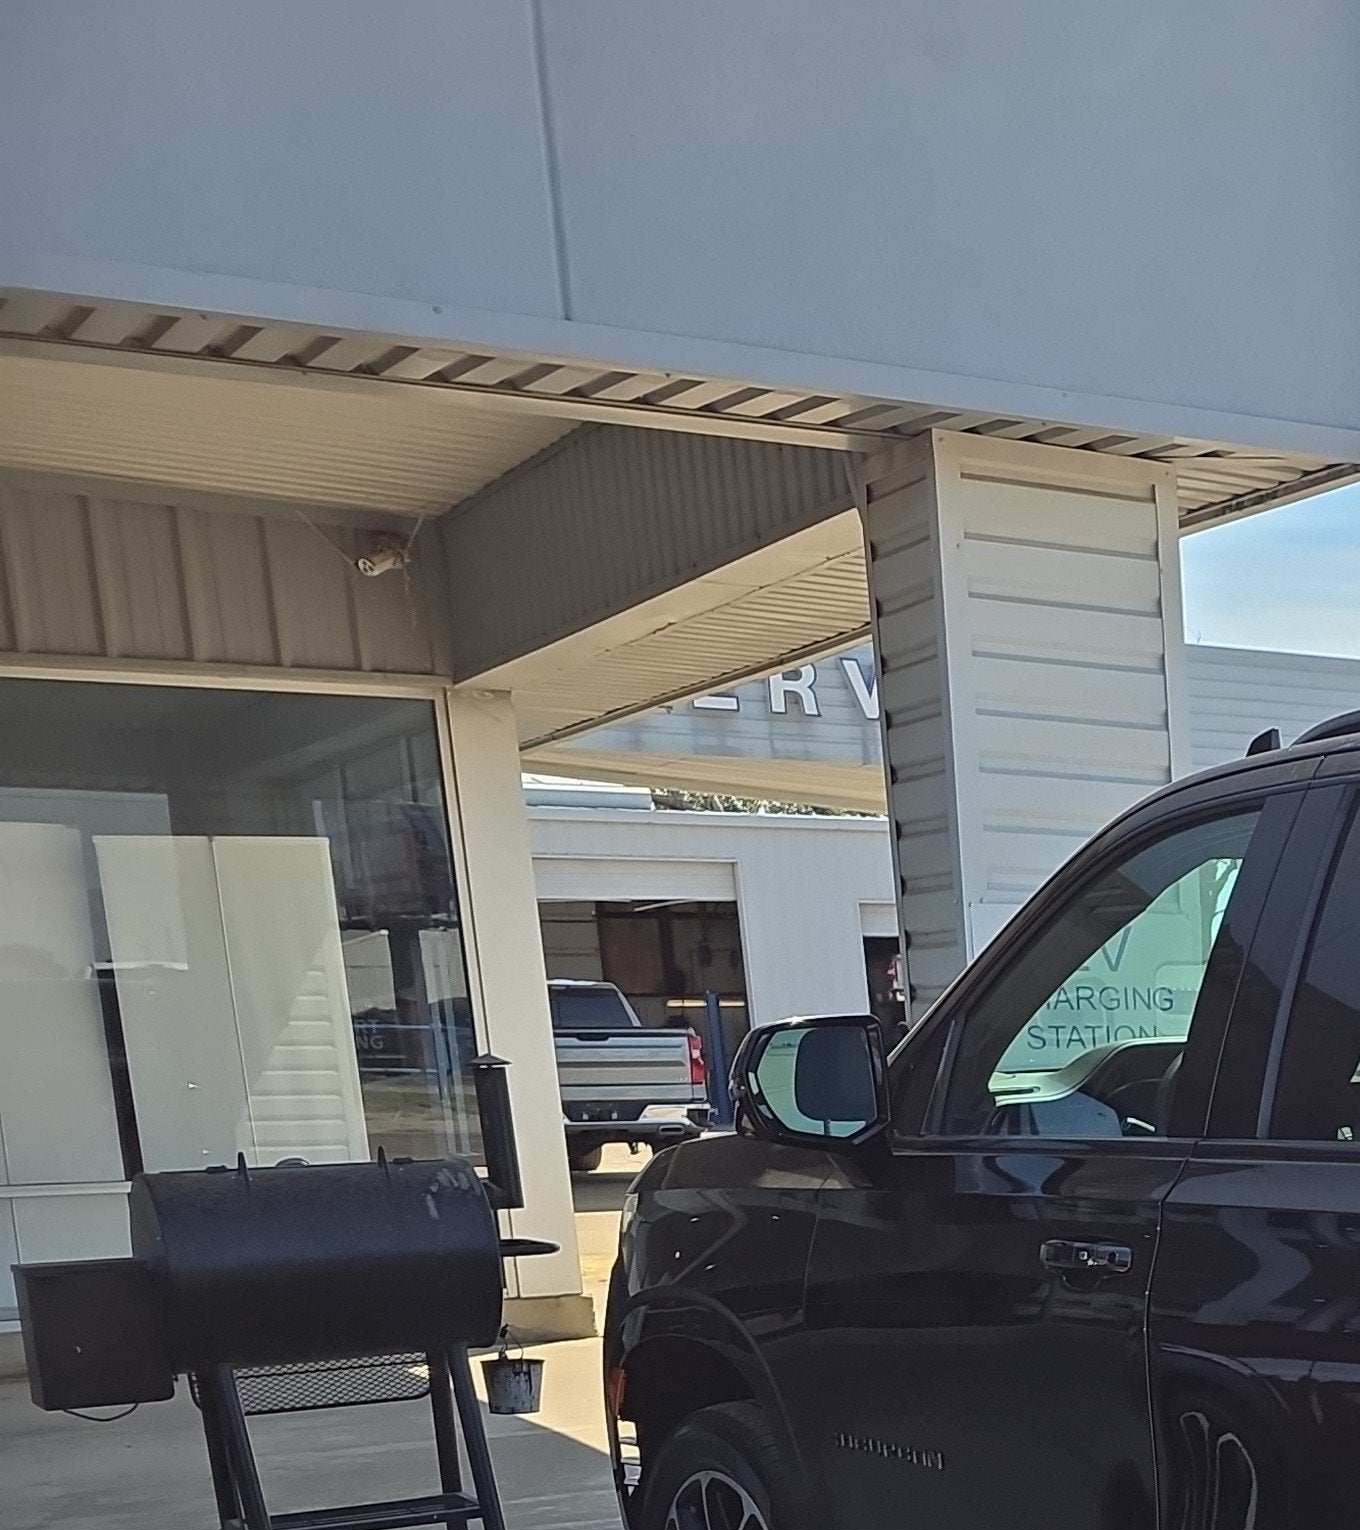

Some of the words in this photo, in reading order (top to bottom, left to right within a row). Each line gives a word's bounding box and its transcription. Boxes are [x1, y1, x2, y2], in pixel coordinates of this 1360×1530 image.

[693, 657, 881, 721] RV
[1076, 926, 1133, 973] V
[1046, 986, 1174, 1012] ARGING
